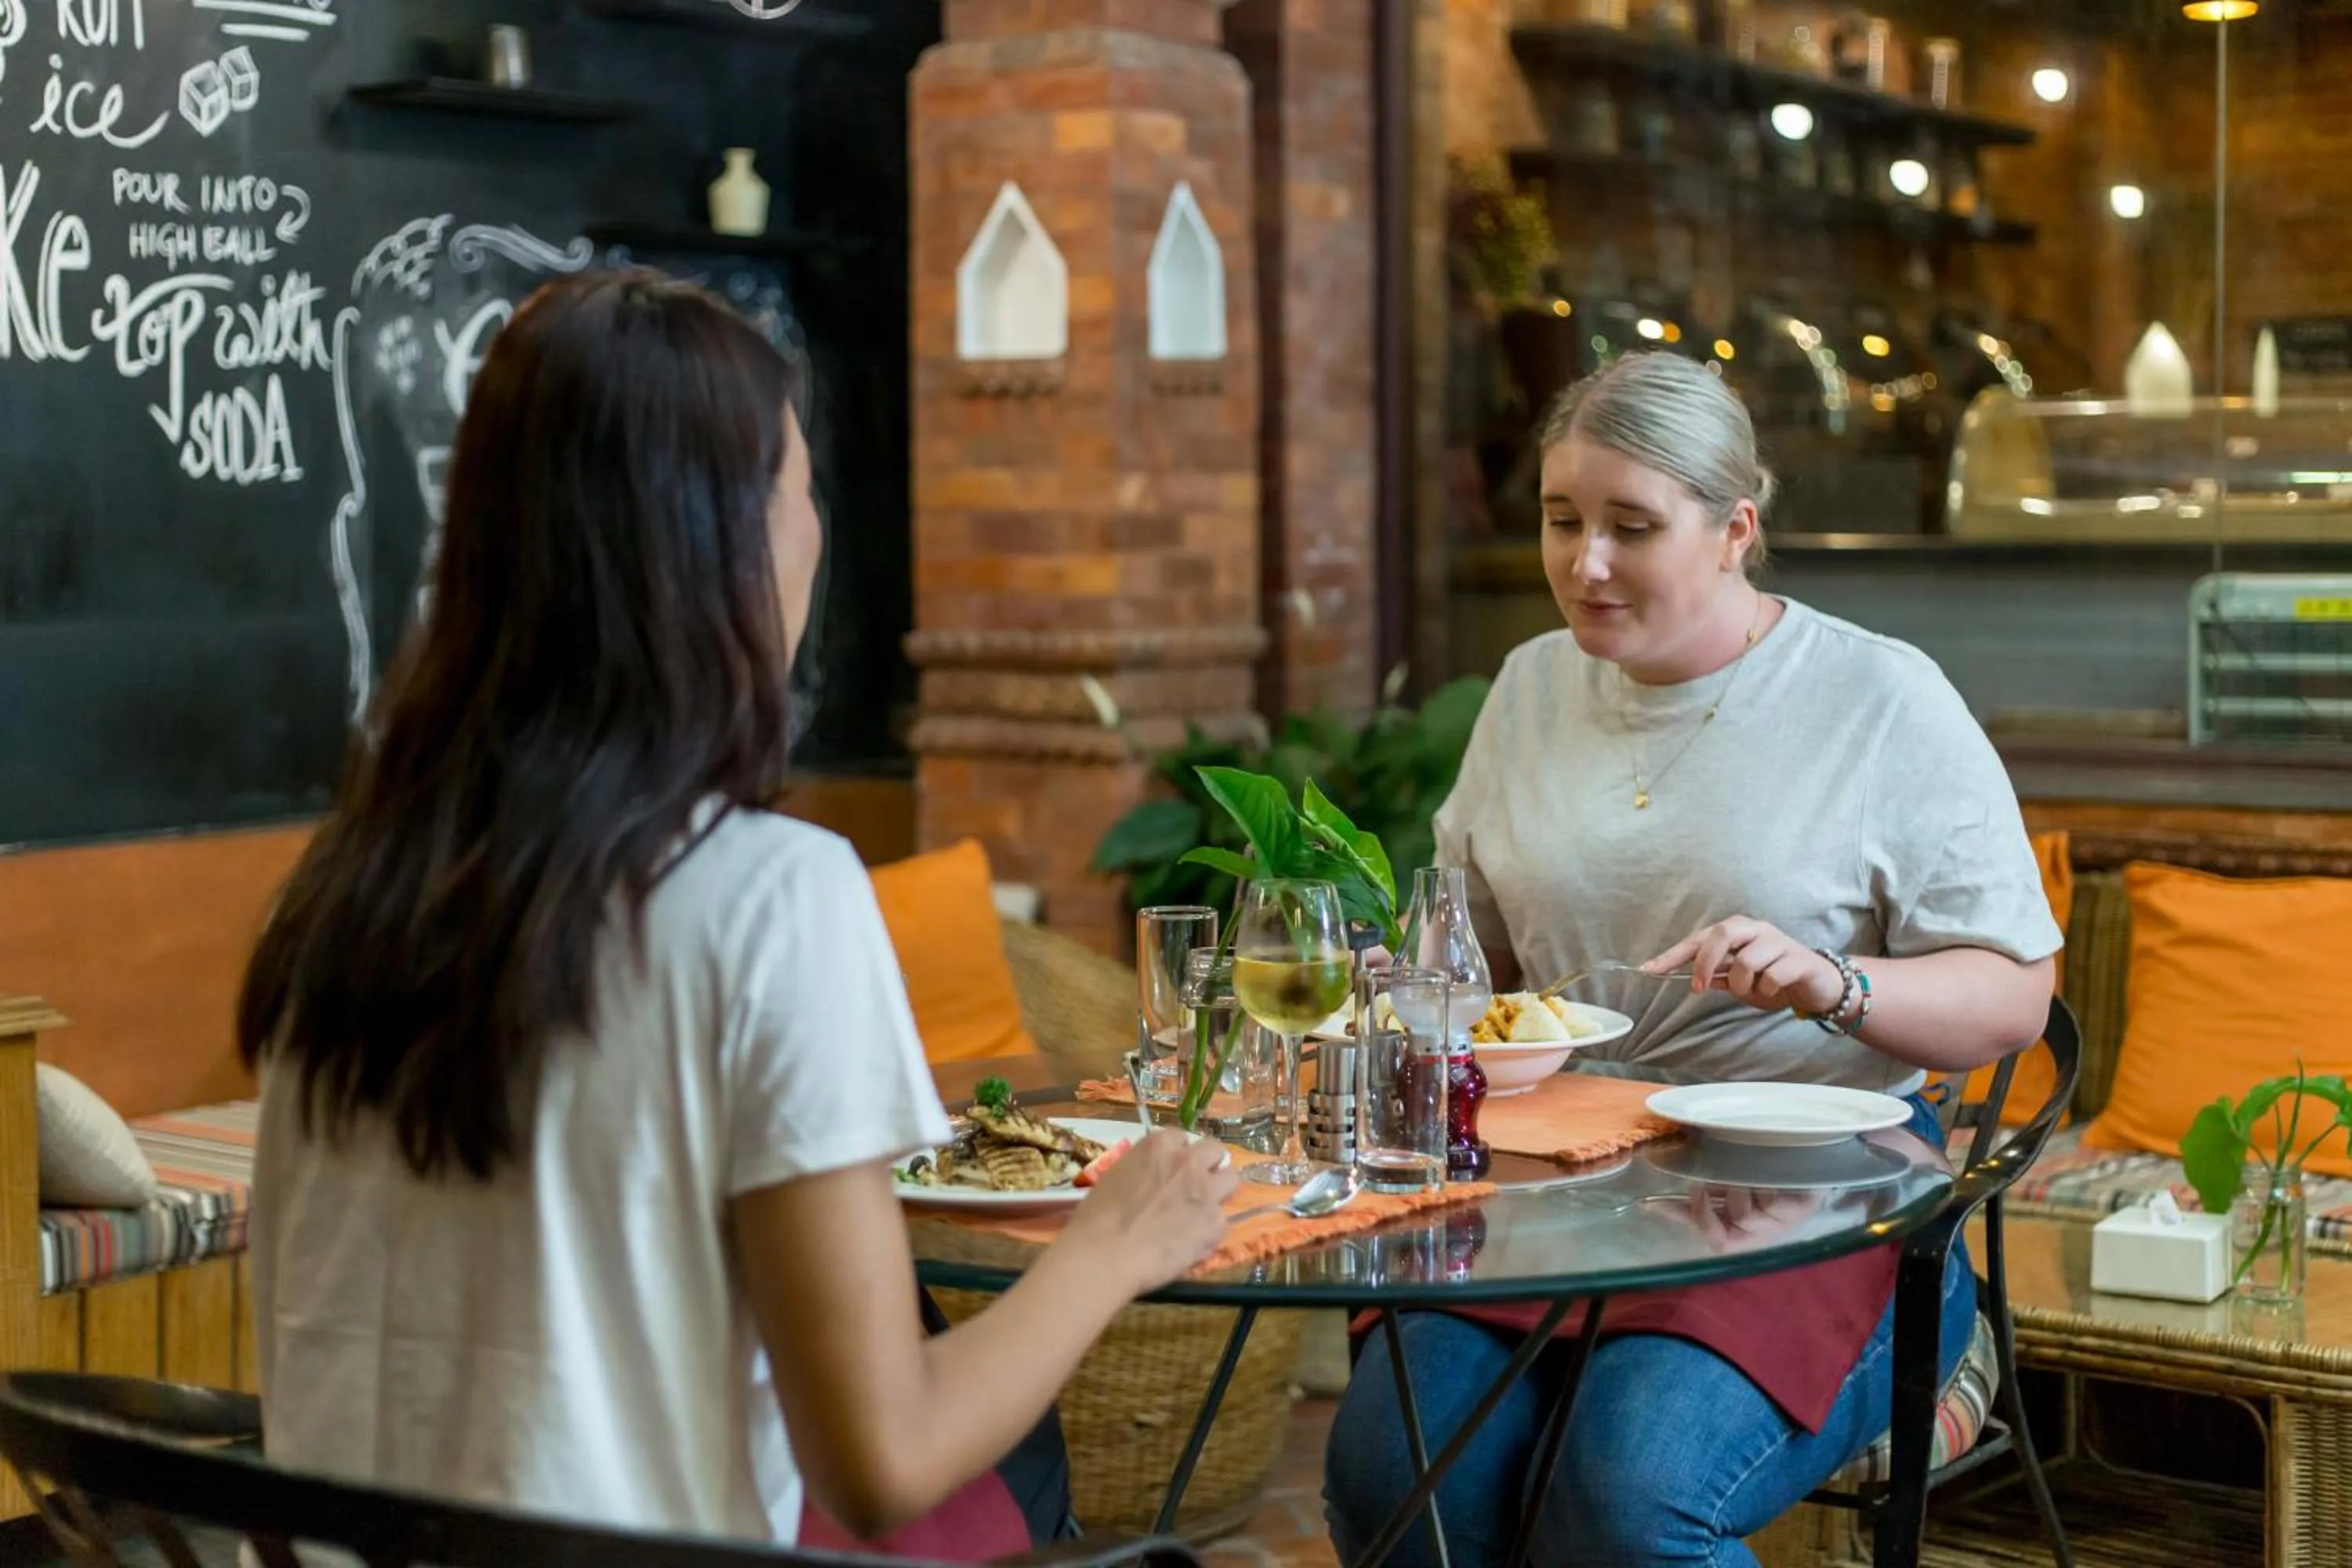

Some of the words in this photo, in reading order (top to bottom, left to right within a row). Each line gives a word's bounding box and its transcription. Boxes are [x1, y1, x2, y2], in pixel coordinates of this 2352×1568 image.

[29, 53, 171, 148] ice
[112, 167, 191, 214] POUR
[201, 174, 278, 214] INTO
[91, 274, 234, 444] top
[213, 269, 333, 372] with
[180, 372, 305, 485] SODA
